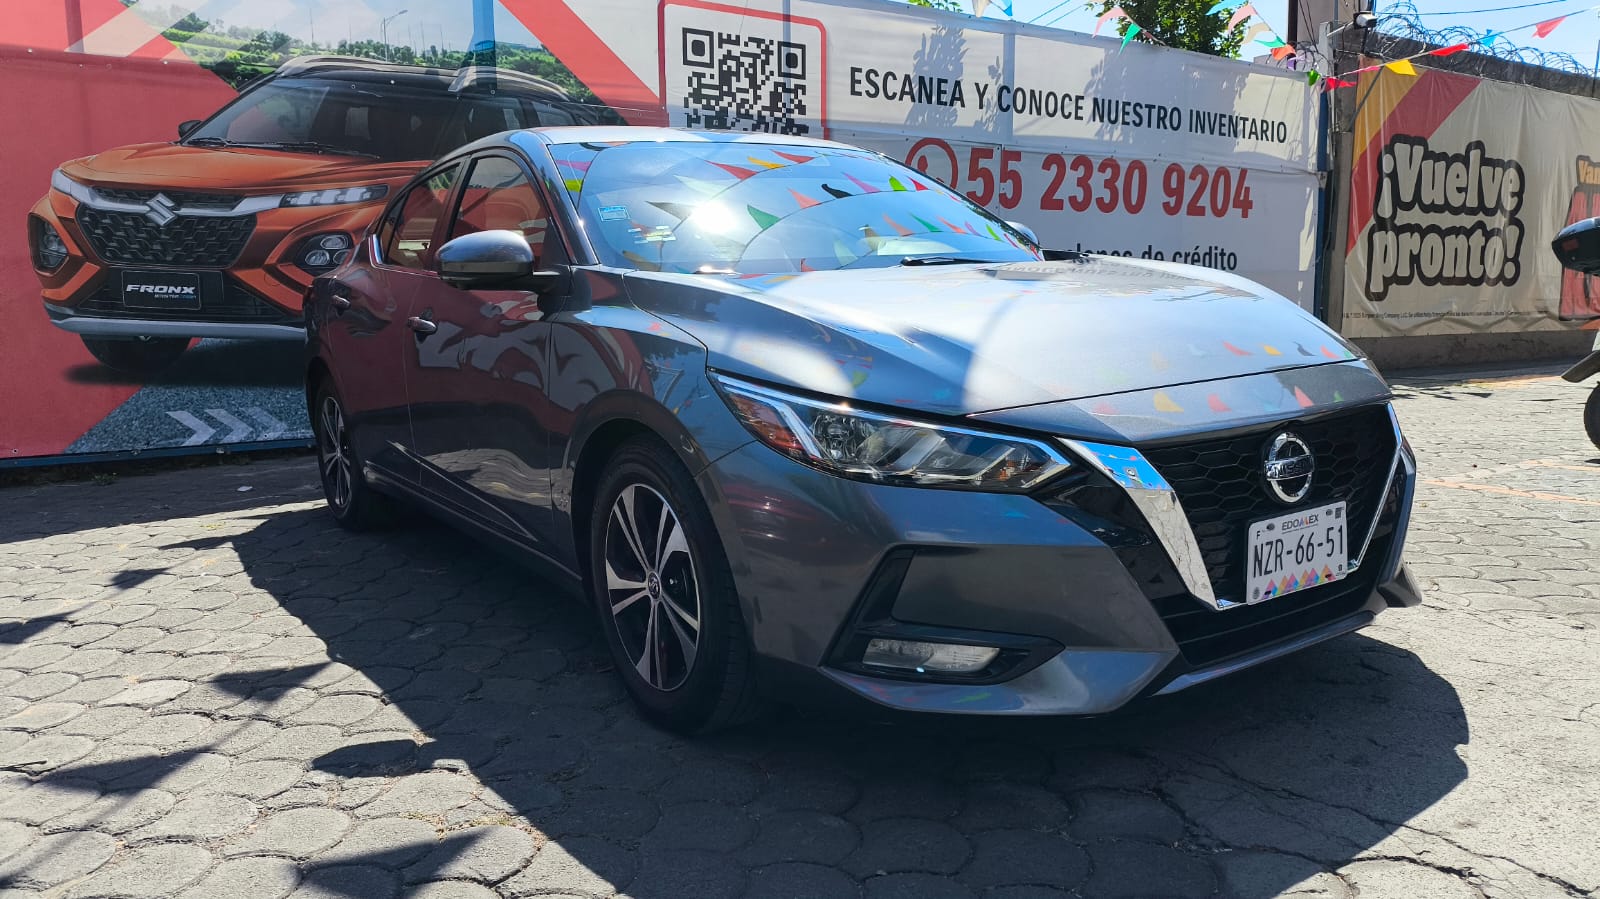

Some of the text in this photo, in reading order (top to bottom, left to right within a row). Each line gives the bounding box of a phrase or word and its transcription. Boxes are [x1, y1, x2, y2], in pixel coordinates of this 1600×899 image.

[850, 66, 1287, 143] ESCANEA Y CONOCE NUESTRO INVENTARIO
[966, 147, 1253, 219] 55 2330 9204
[1375, 138, 1523, 220] ¡Vuelve
[126, 284, 196, 294] FRONX
[1172, 246, 1238, 271] crédito
[1368, 223, 1522, 295] pronto!
[1253, 525, 1343, 578] NZR-66-51
